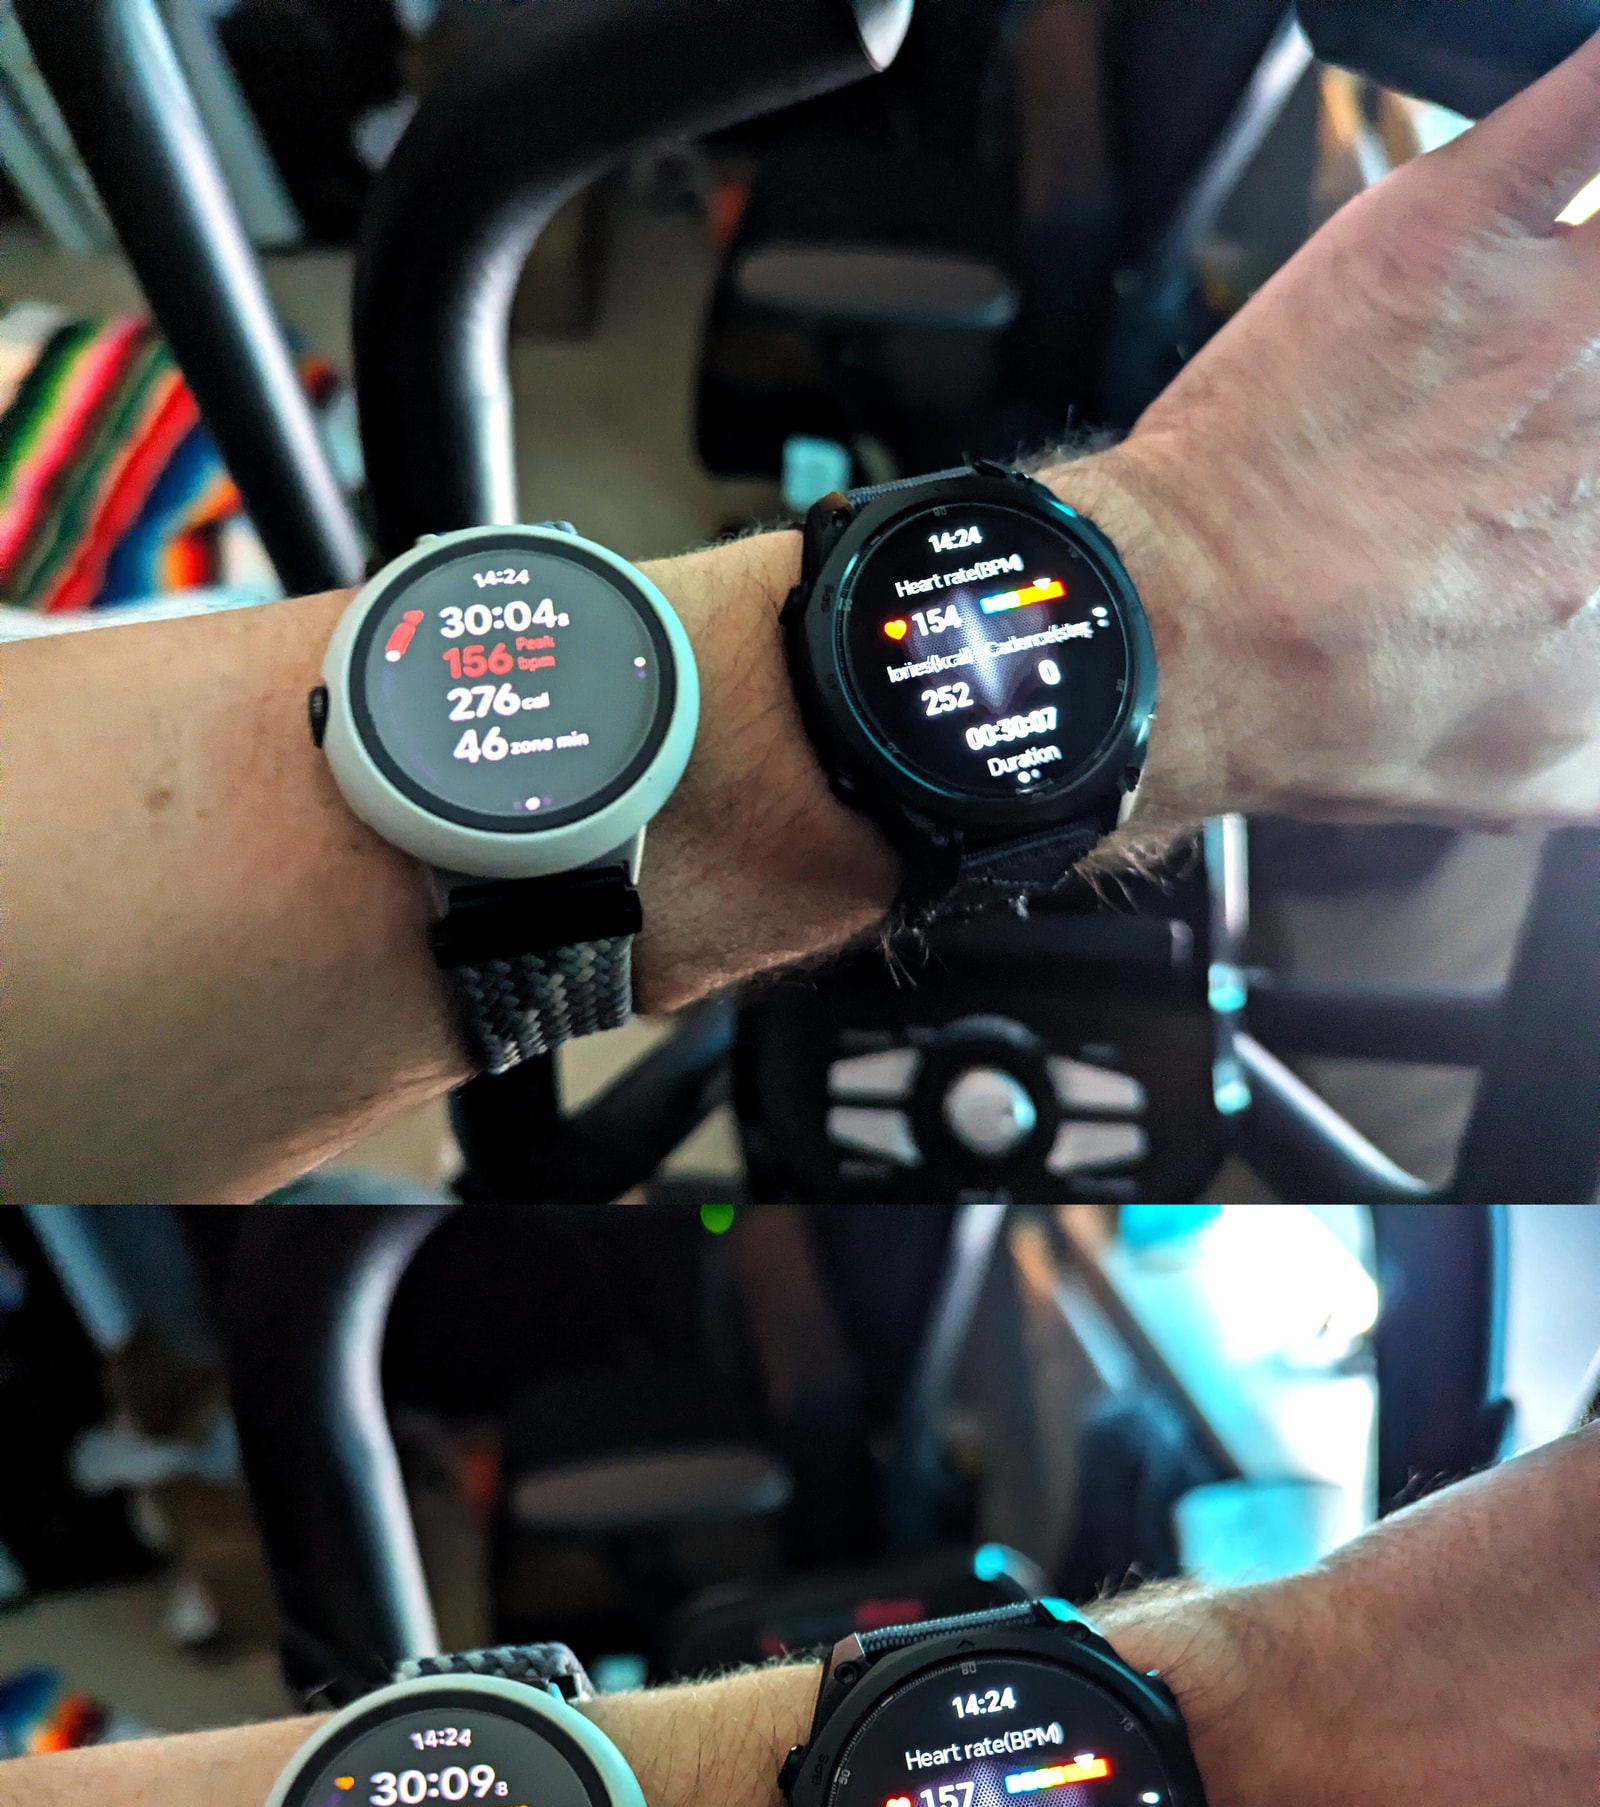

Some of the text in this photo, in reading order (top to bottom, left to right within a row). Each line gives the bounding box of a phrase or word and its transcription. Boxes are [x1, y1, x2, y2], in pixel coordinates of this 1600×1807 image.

[928, 526, 982, 553] 14:24
[473, 568, 530, 588] 14:24
[894, 575, 942, 598] Heart
[911, 604, 962, 637] 154
[443, 635, 555, 679] 156 Peak
[518, 654, 555, 672] bpm
[1037, 658, 1061, 686] 0
[447, 683, 550, 722] 276 cal
[921, 681, 974, 717] 252
[453, 726, 589, 763] 46 zone min
[965, 706, 1058, 751] 00:30:07
[987, 745, 1062, 777] Duration
[952, 1687, 1017, 1719] 14:24
[410, 1728, 471, 1750] 14:24
[905, 1722, 1064, 1771] Heart rate(BPM)
